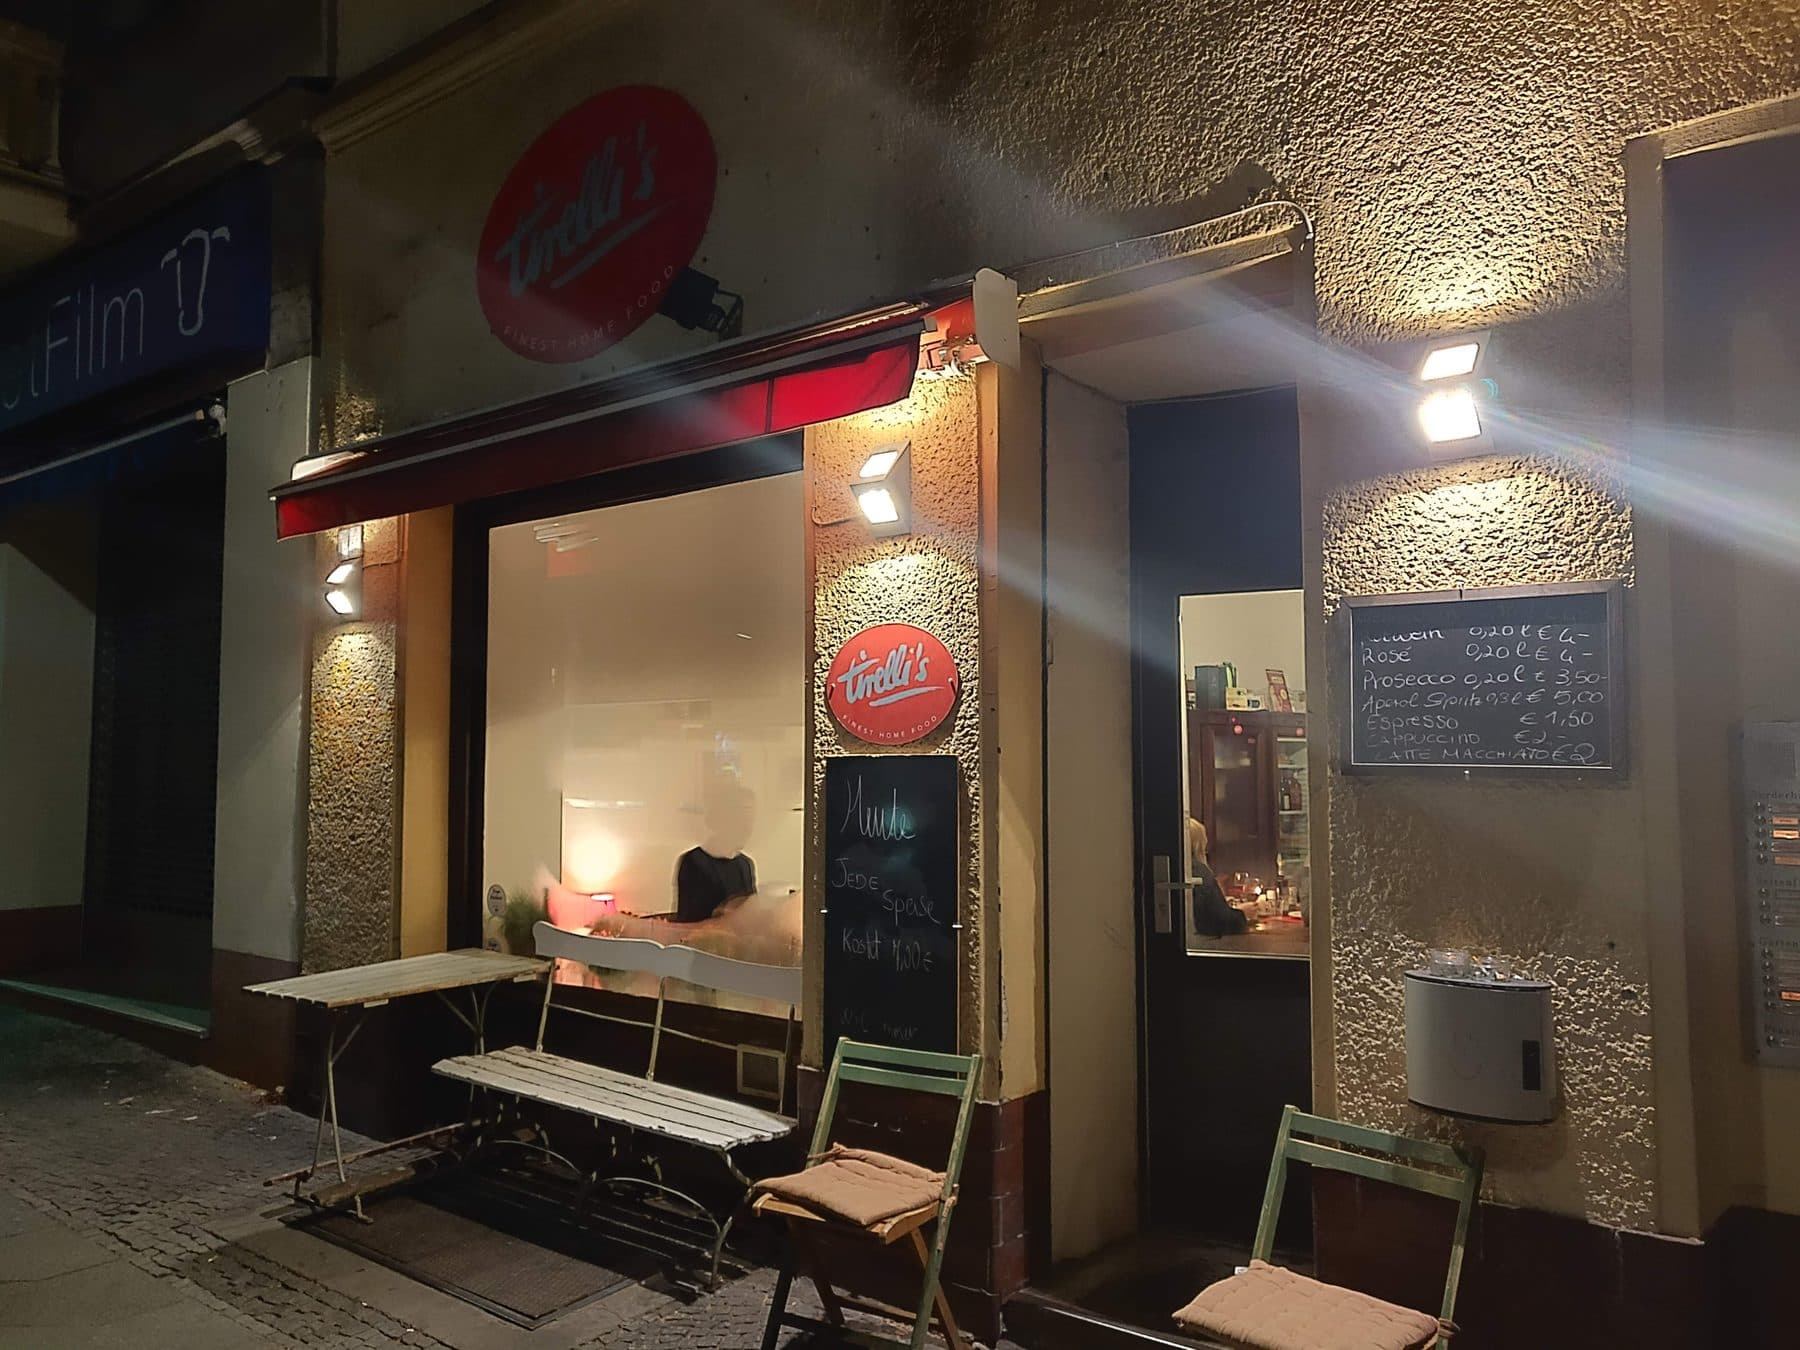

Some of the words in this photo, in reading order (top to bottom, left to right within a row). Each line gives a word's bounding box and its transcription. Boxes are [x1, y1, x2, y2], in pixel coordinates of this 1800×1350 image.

[494, 119, 660, 300] tirelli's
[503, 325, 559, 353] FINEST
[567, 319, 617, 348] HOME
[625, 264, 674, 321] FOOD
[1362, 646, 1412, 666] Rosé
[836, 642, 930, 704] tirelli's
[1363, 669, 1456, 690] Prosecco
[1553, 690, 1605, 706] 5,00
[842, 713, 874, 737] FINEST
[879, 730, 905, 739] HOME
[911, 715, 938, 735] FOOD
[1366, 714, 1459, 737] Espresso
[1544, 709, 1594, 728] 1,50
